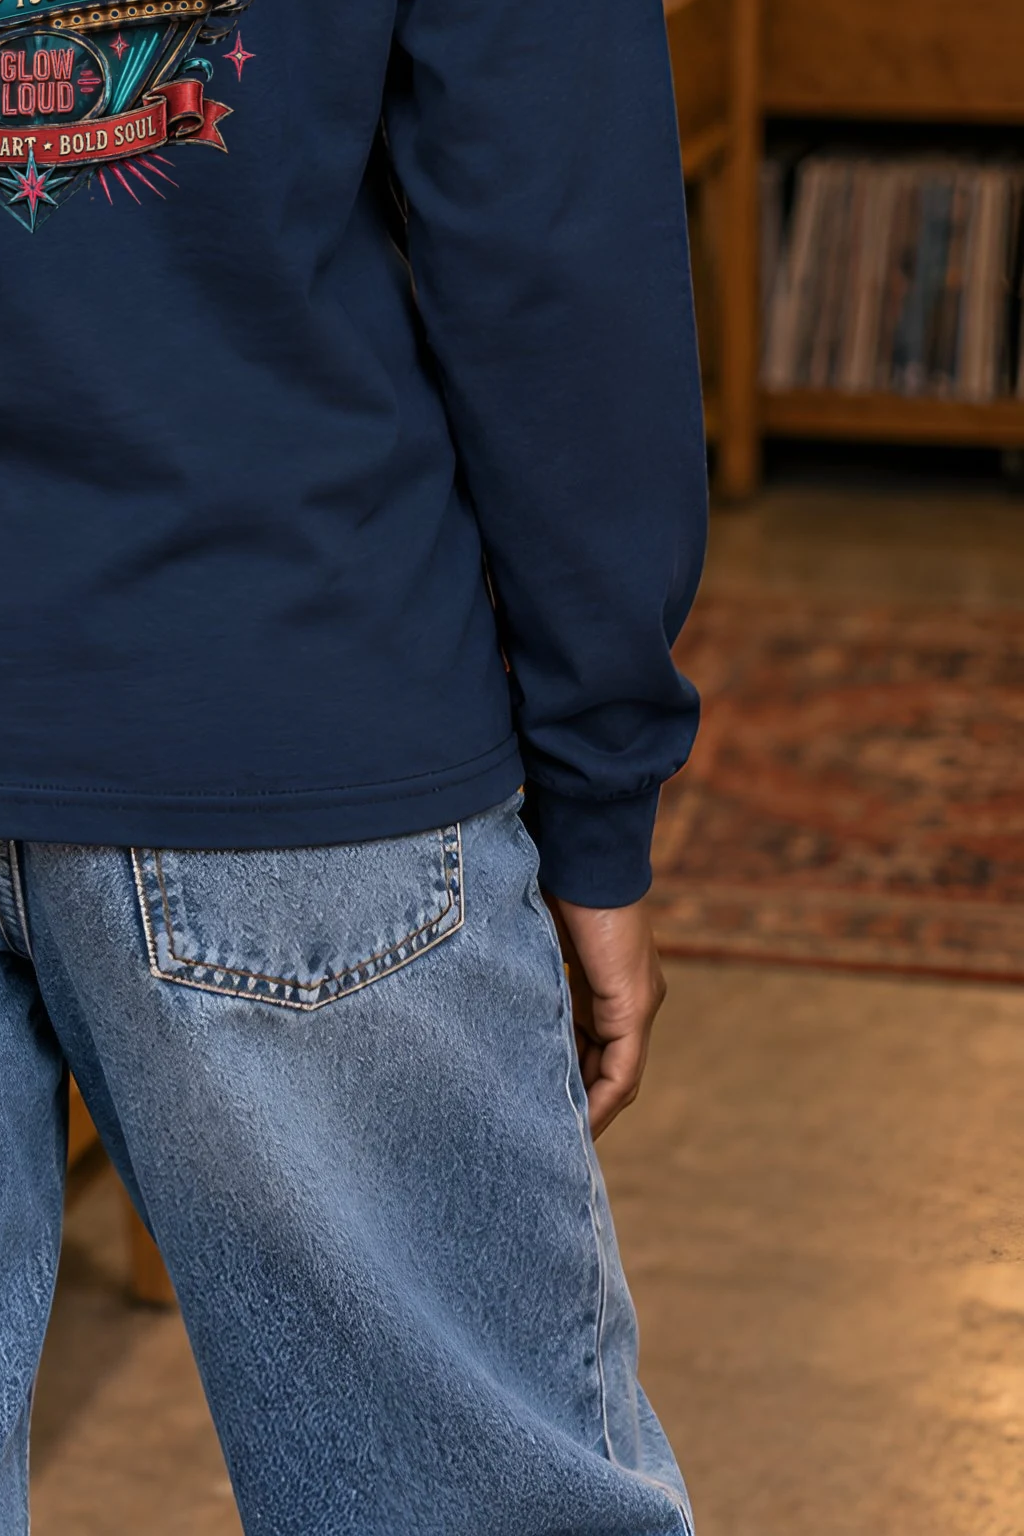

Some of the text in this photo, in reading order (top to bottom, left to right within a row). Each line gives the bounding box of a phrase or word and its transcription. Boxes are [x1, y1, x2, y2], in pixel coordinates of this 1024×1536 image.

[0, 48, 75, 82] GLOW
[1, 81, 75, 116] LOUD
[59, 132, 110, 156] BOLD
[113, 115, 157, 147] SOUL
